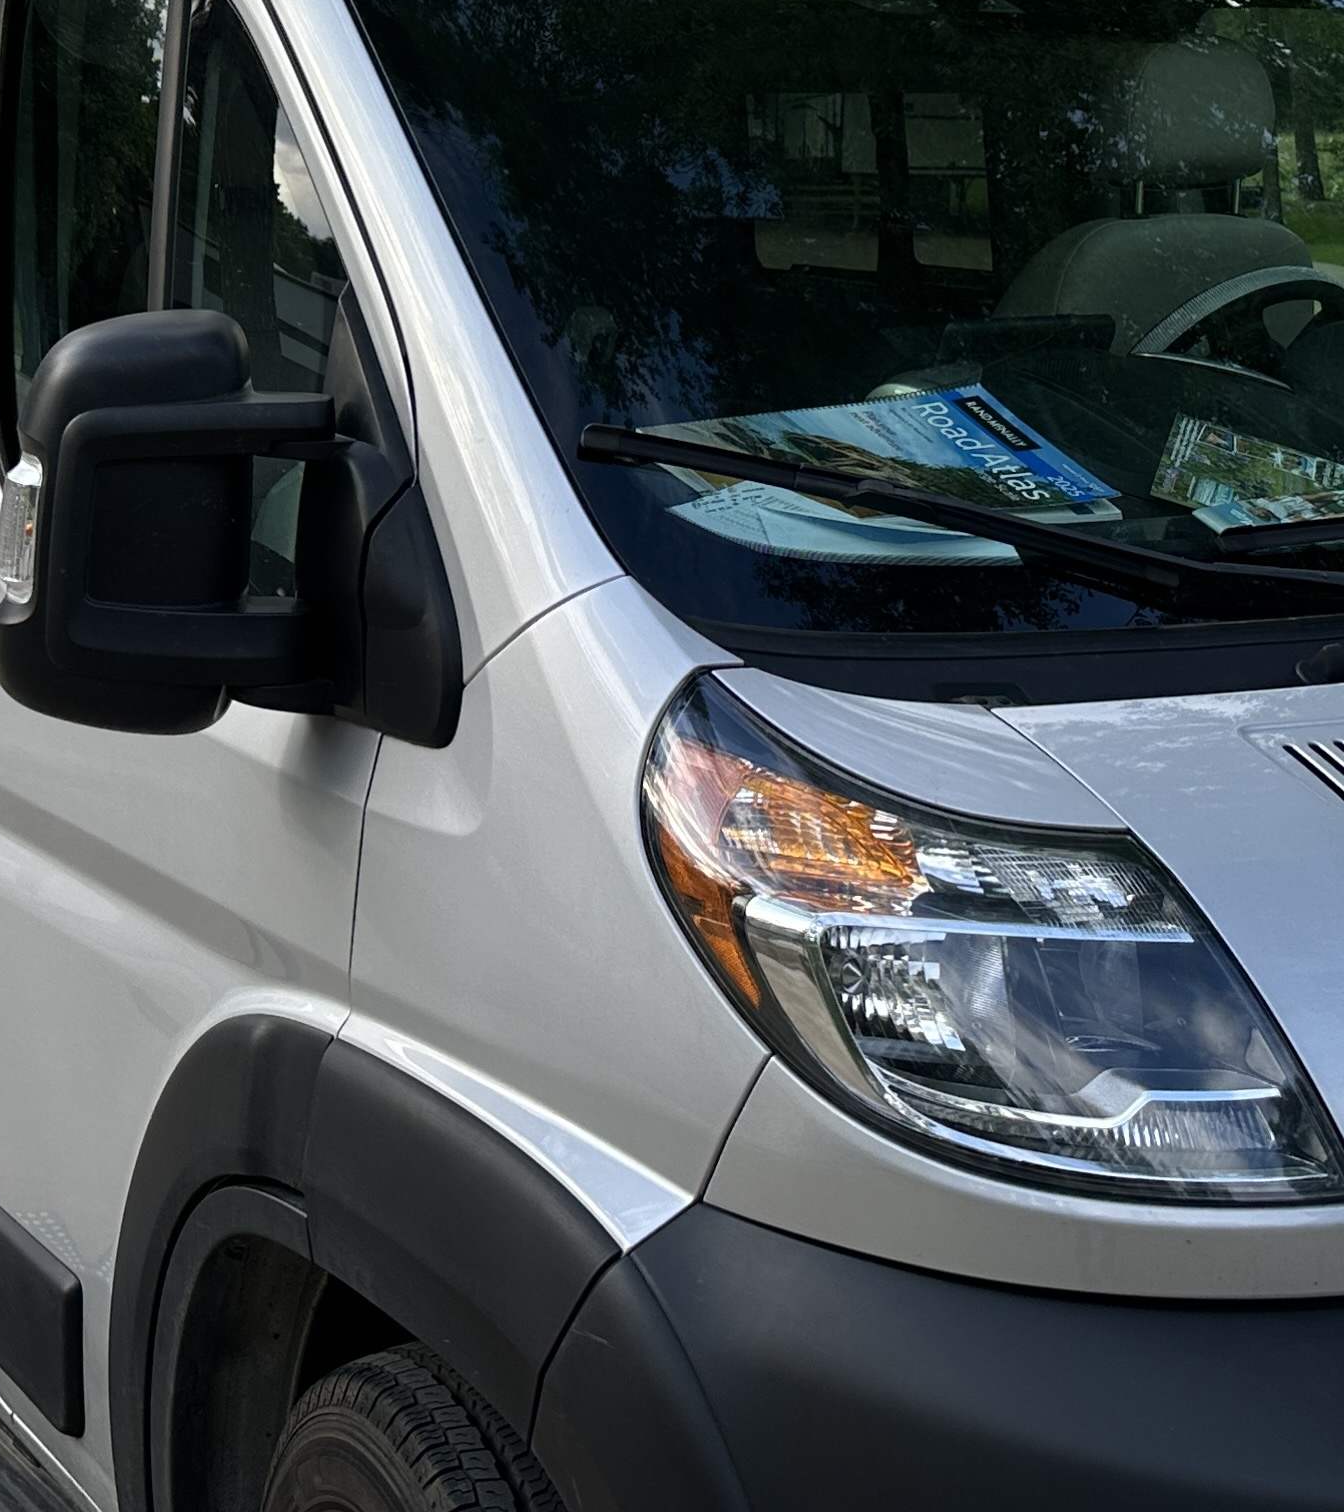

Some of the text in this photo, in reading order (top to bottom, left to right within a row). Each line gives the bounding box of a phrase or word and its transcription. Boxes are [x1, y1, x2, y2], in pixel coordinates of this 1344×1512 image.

[964, 400, 994, 422] RAND
[910, 401, 996, 451] Road
[970, 452, 1050, 501] Atlas
[1046, 475, 1087, 497] 2025
